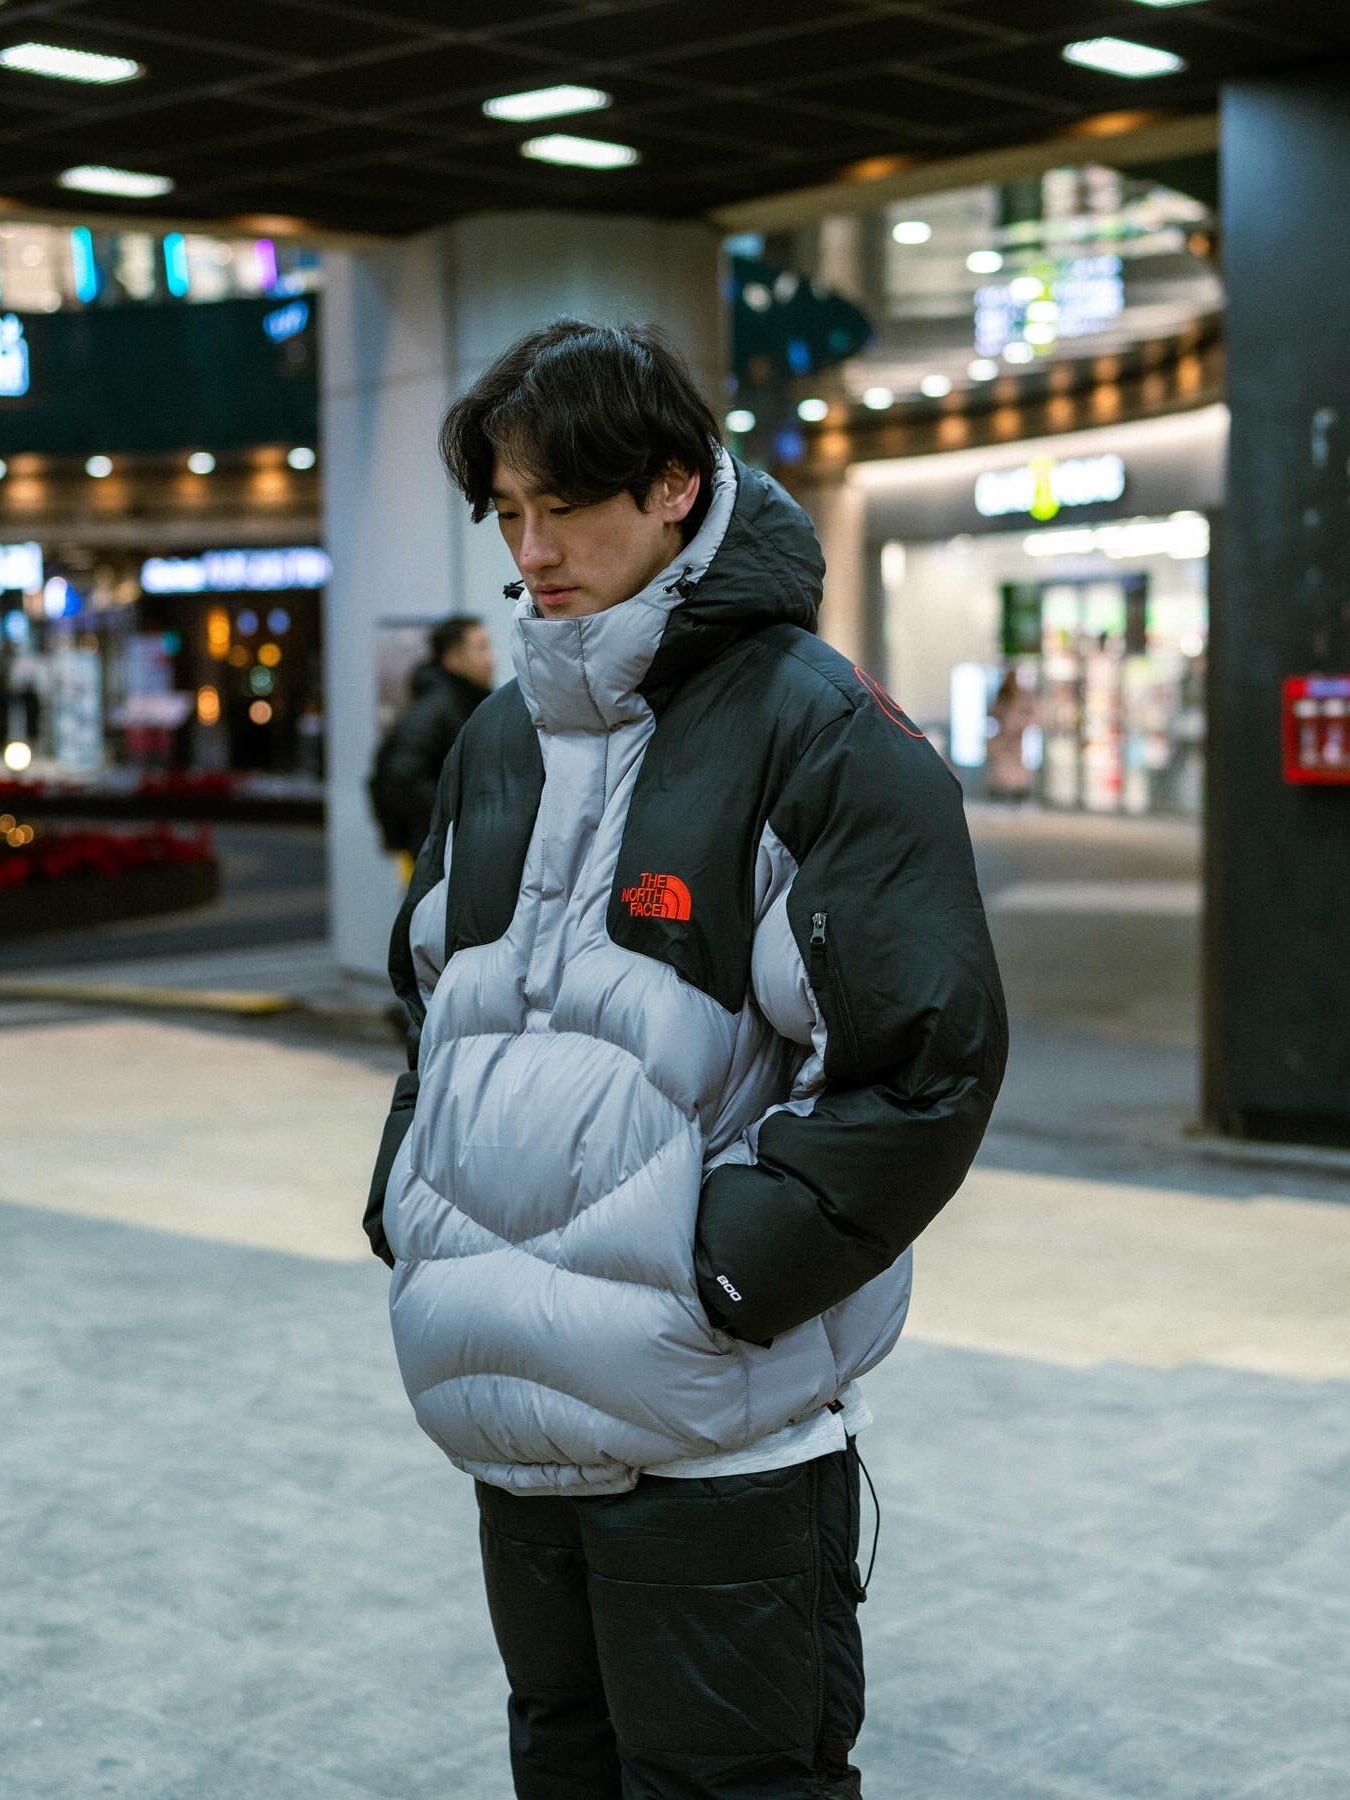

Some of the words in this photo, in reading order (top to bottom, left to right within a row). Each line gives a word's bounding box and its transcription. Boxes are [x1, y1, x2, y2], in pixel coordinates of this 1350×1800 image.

[640, 872, 667, 889] THE
[621, 887, 664, 903] NORTH
[630, 902, 661, 917] FACE
[716, 1275, 742, 1301] 800
